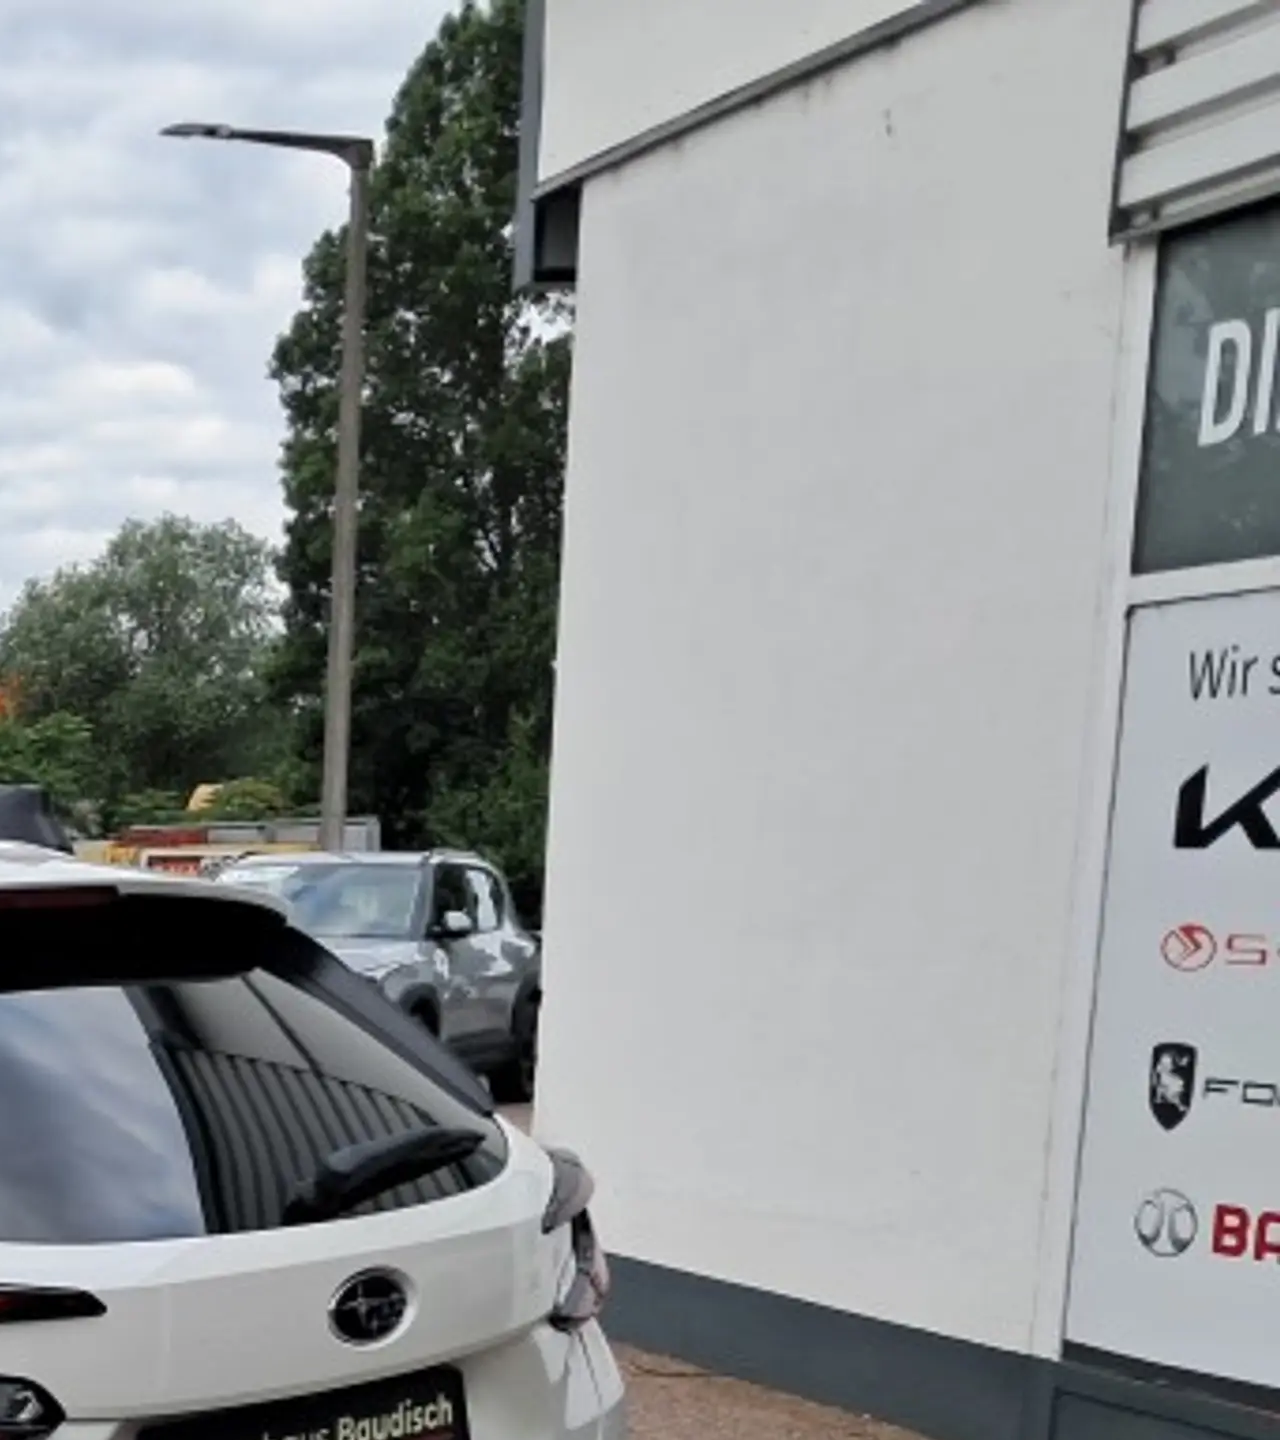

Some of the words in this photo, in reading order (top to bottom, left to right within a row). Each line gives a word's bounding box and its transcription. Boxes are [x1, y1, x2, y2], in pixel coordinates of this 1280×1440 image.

[1197, 307, 1280, 448] DI
[1189, 644, 1259, 700] Wir
[1226, 933, 1280, 966] S
[1204, 1077, 1280, 1107] FO
